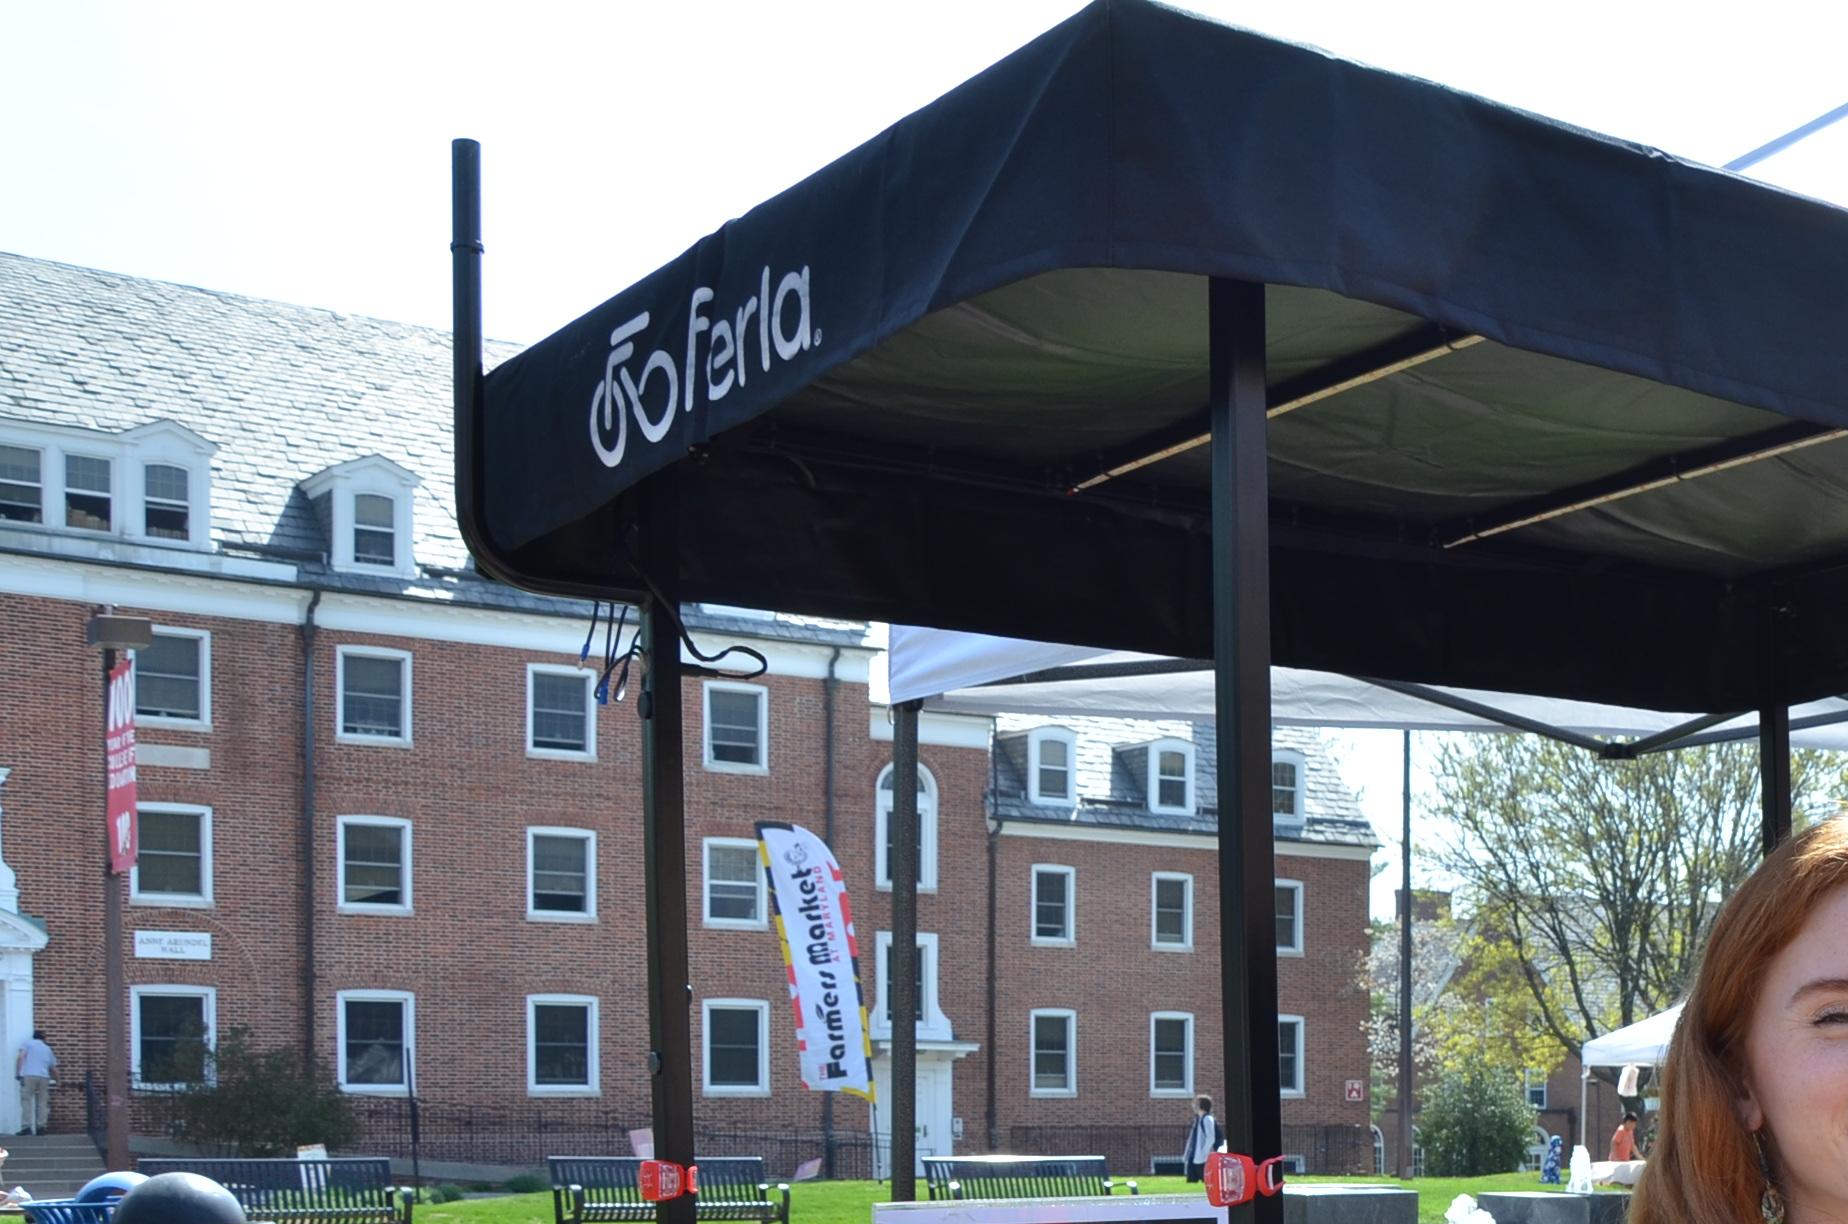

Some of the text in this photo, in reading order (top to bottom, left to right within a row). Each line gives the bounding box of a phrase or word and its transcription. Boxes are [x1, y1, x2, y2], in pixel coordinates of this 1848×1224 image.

[813, 865, 837, 942] MARYLAND
[161, 945, 186, 955] HALL
[818, 970, 848, 1081] Farmers
